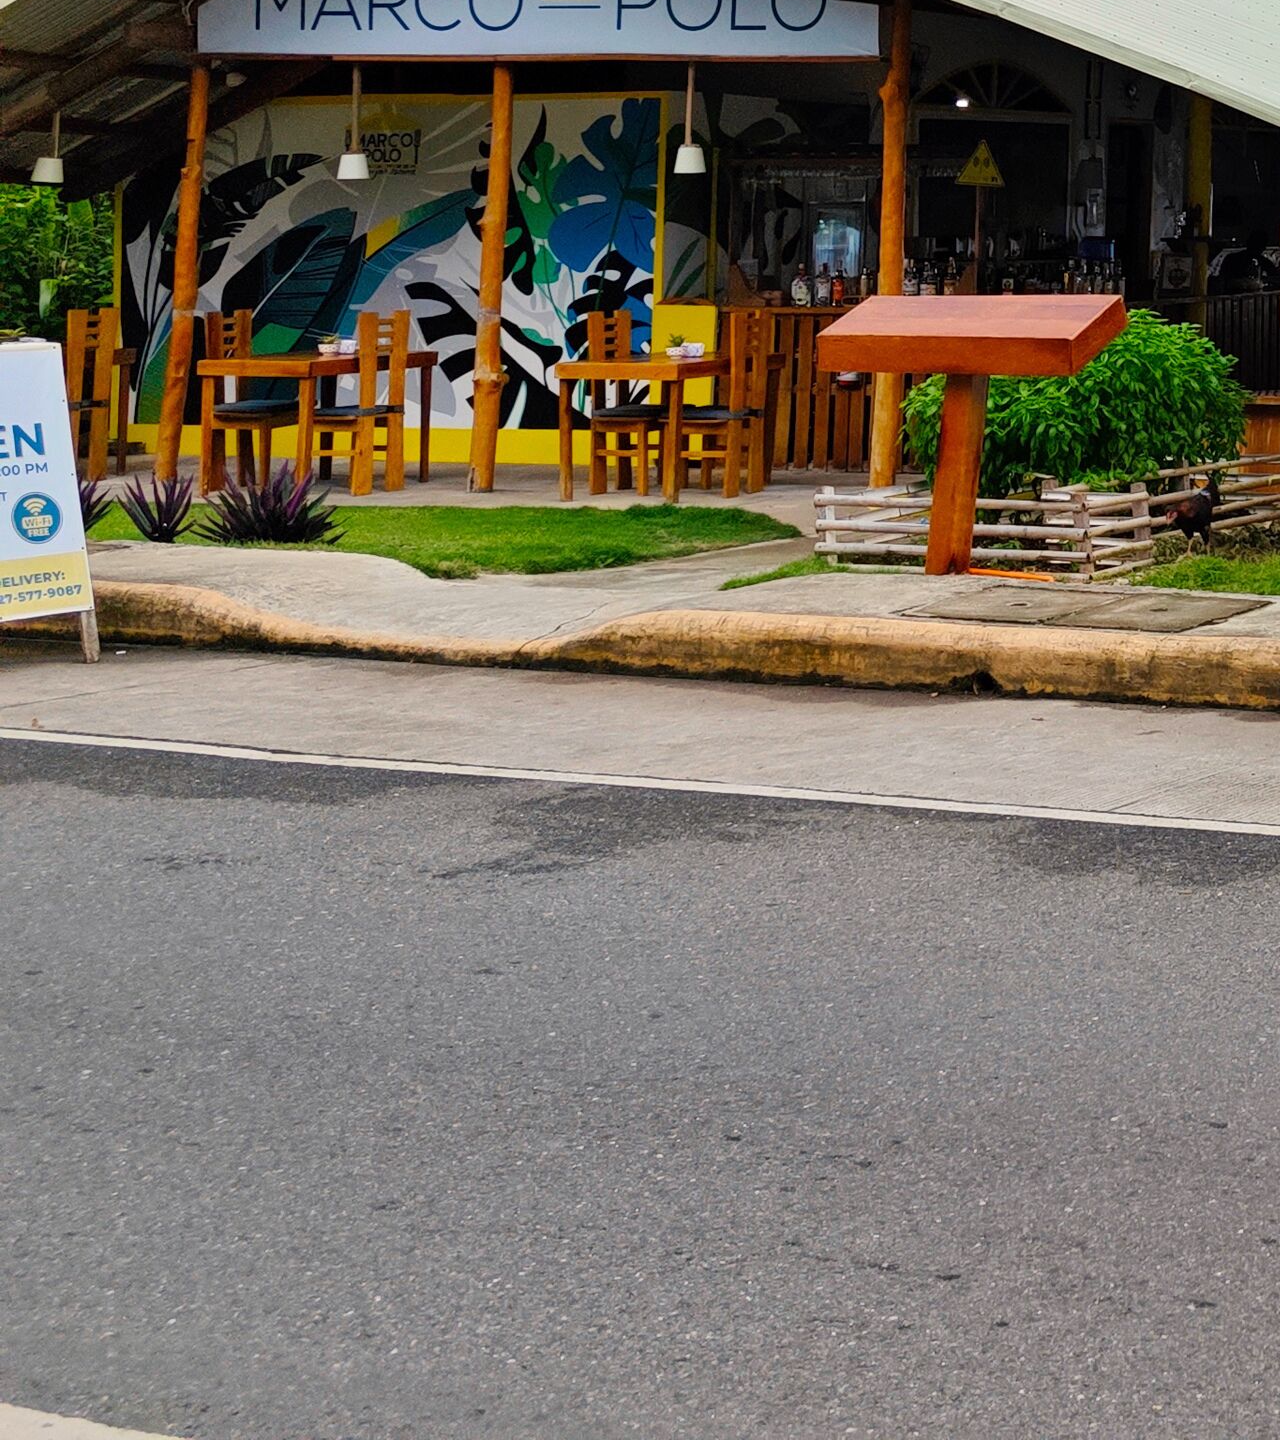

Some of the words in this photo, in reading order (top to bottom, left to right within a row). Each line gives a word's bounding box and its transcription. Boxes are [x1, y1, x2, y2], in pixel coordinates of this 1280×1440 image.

[25, 462, 48, 475] PM
[24, 516, 51, 528] Wi-Fi
[28, 527, 51, 537] FREE
[0, 570, 66, 589] ELIVERY:
